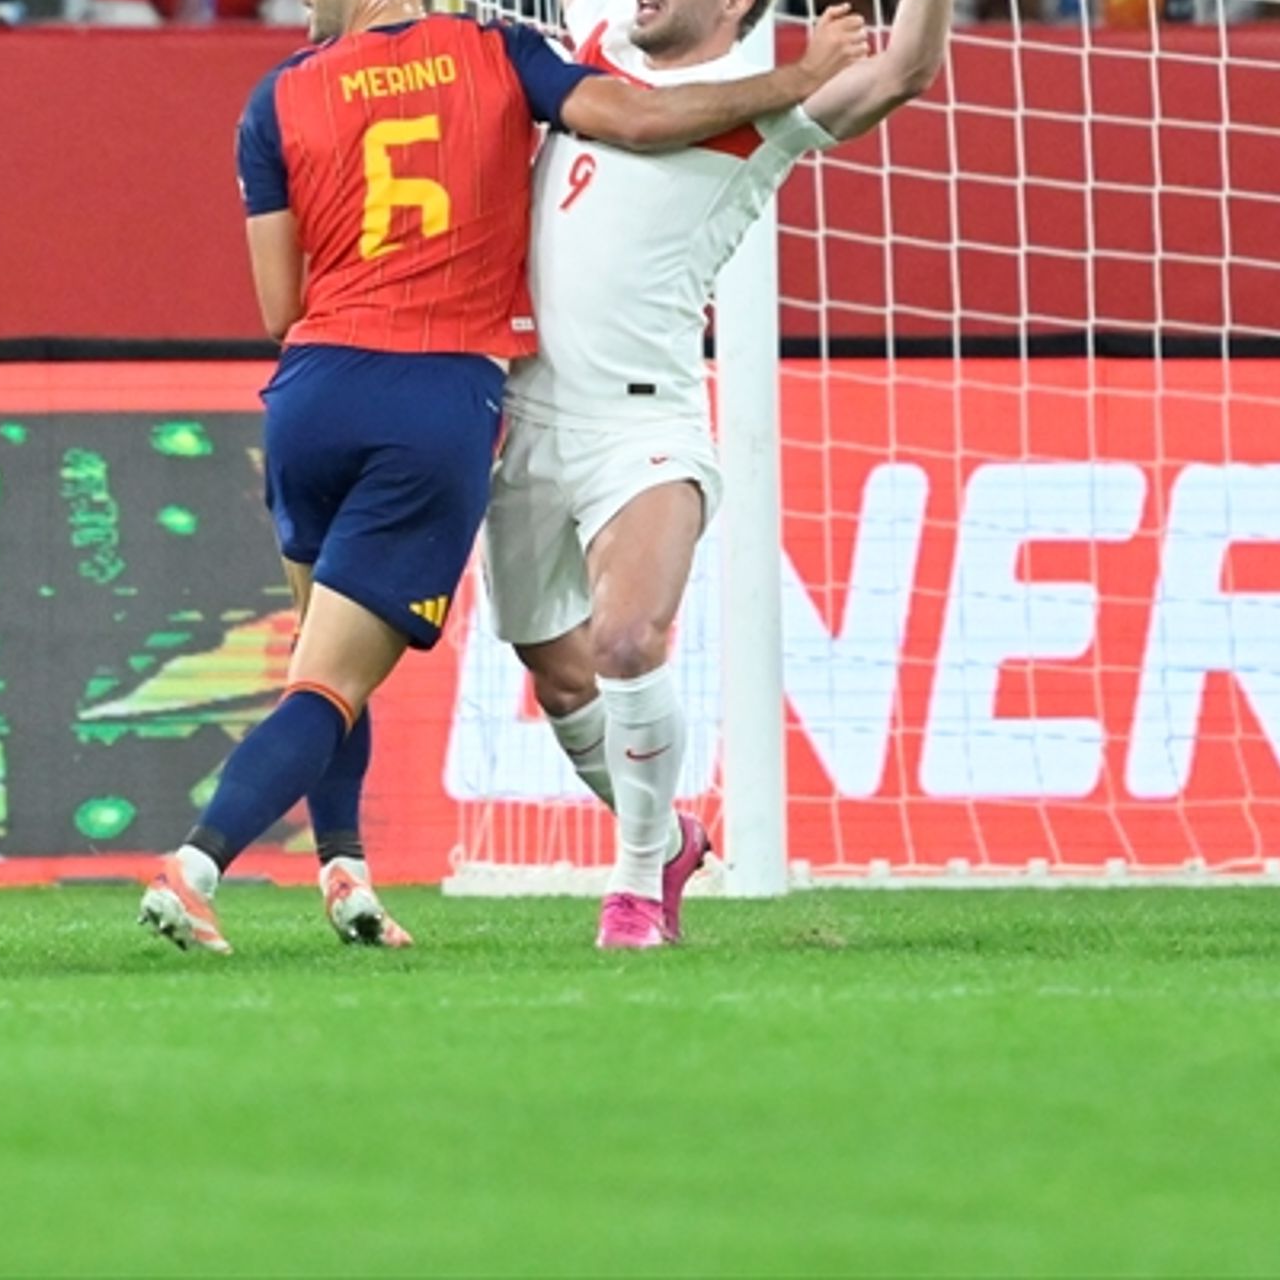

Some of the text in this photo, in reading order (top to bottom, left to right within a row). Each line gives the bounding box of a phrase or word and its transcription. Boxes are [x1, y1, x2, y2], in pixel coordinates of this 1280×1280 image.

[340, 54, 457, 103] MERINO
[359, 114, 451, 261] 6
[560, 153, 597, 212] 9
